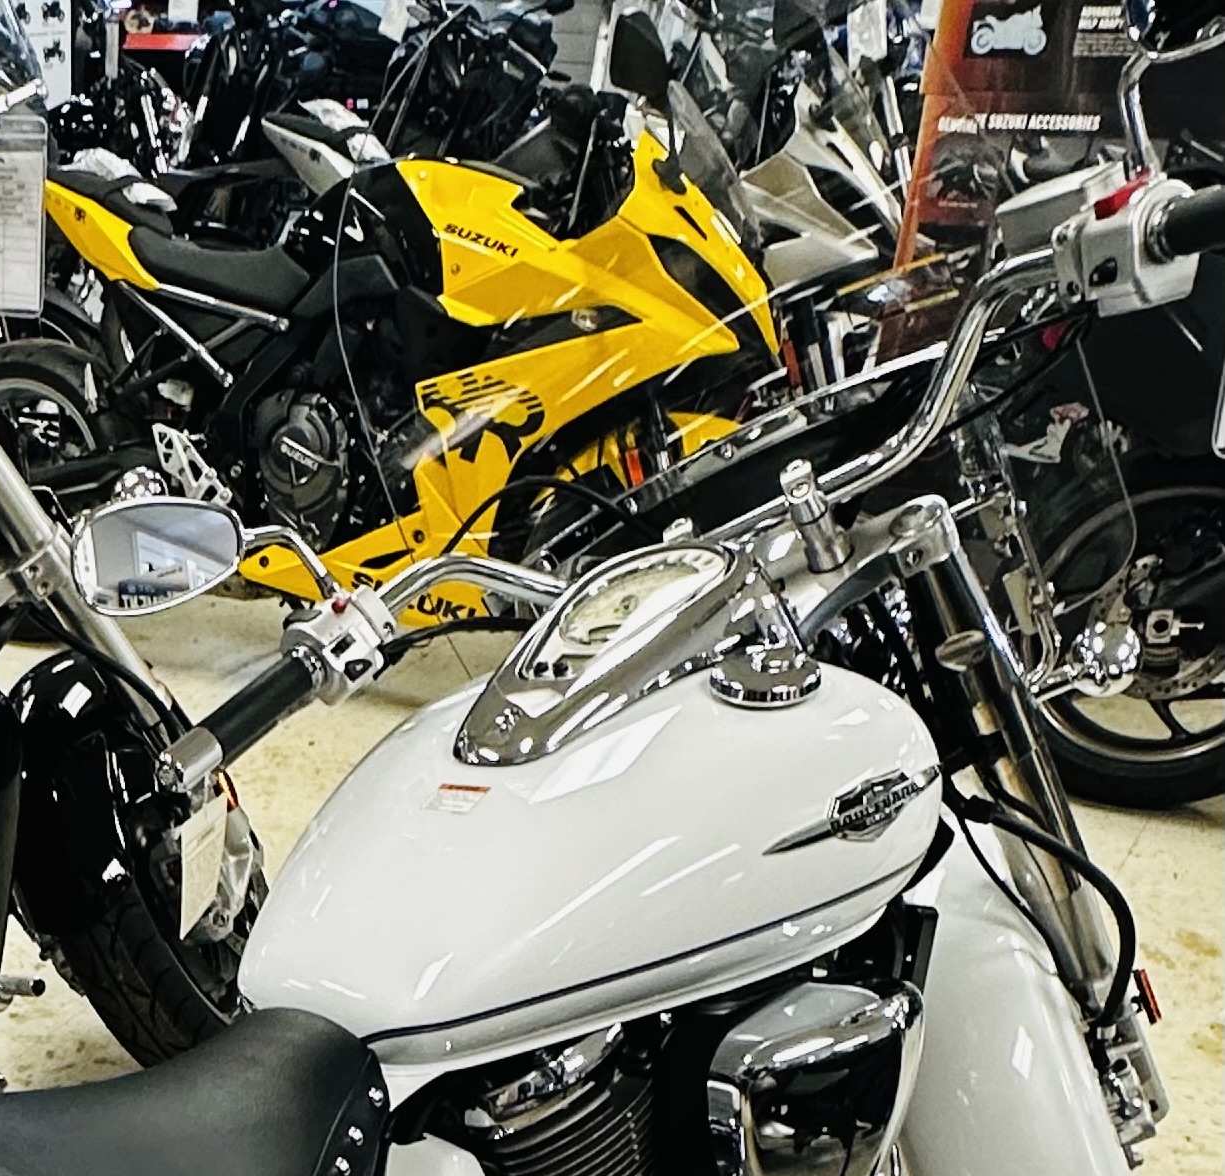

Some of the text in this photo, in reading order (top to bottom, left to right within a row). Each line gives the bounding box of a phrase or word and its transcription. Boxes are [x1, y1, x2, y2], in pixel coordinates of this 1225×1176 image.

[987, 113, 1028, 130] SUZUKI
[1027, 114, 1102, 131] ACCESSORIES
[443, 223, 519, 258] SUZUKI
